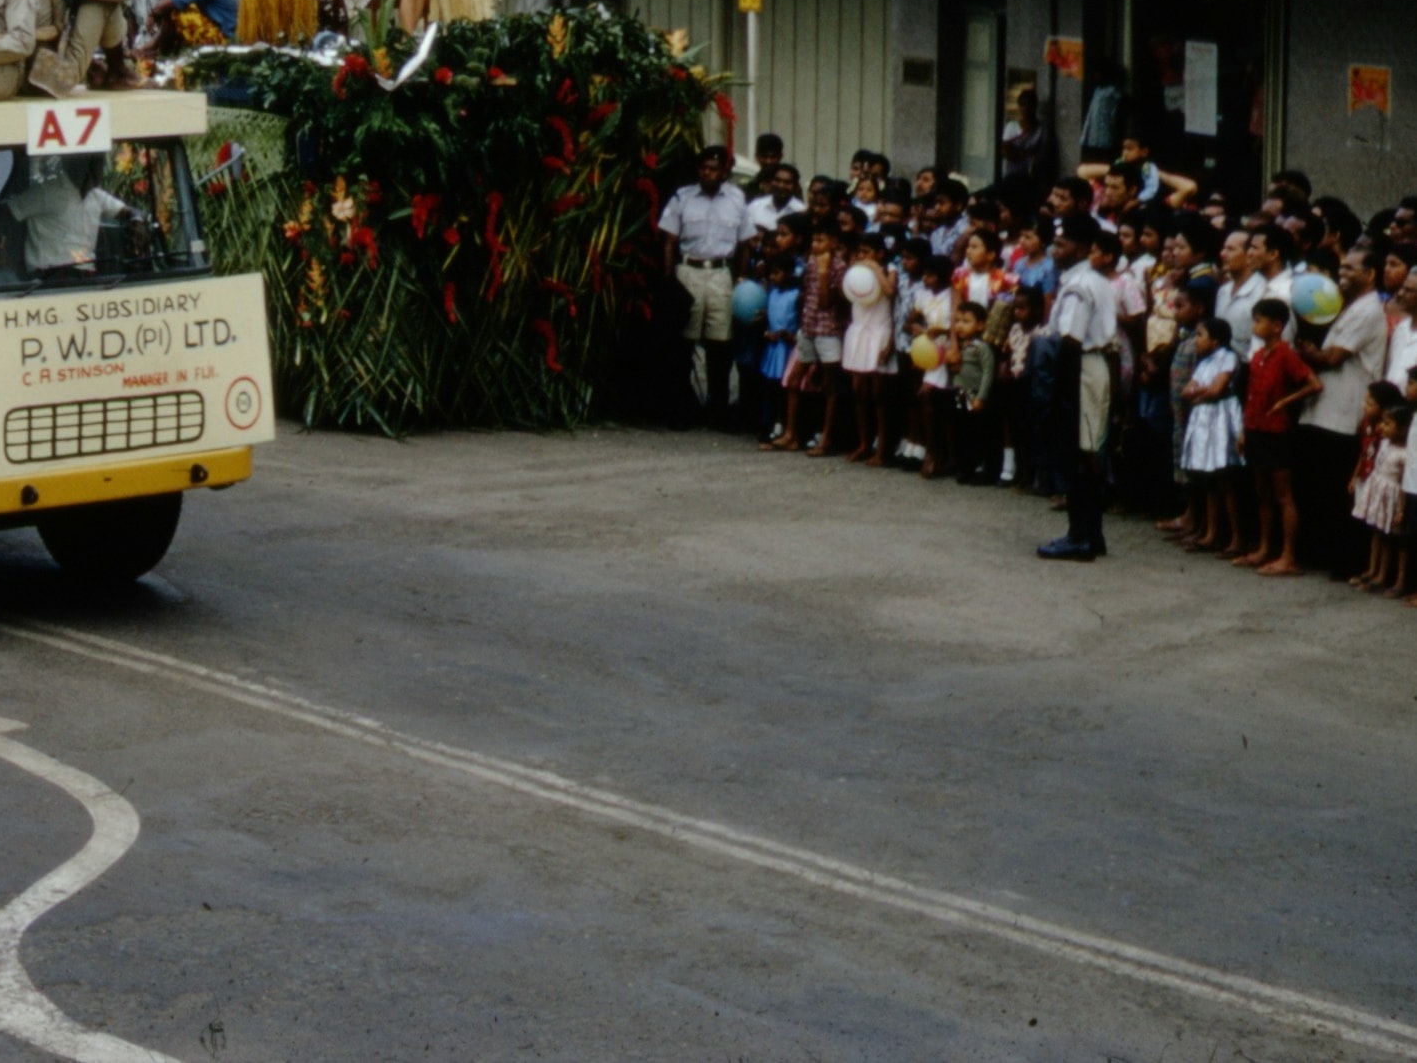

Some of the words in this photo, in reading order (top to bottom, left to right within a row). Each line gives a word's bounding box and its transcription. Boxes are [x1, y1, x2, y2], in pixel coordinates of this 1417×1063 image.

[37, 107, 101, 148] A7
[4, 308, 63, 329] H.M.G.
[76, 293, 201, 322] SUBSIDIARY
[184, 318, 236, 349] LTD.
[57, 362, 125, 382] STINSON
[122, 371, 168, 388] MANAGER
[176, 369, 188, 383] IN
